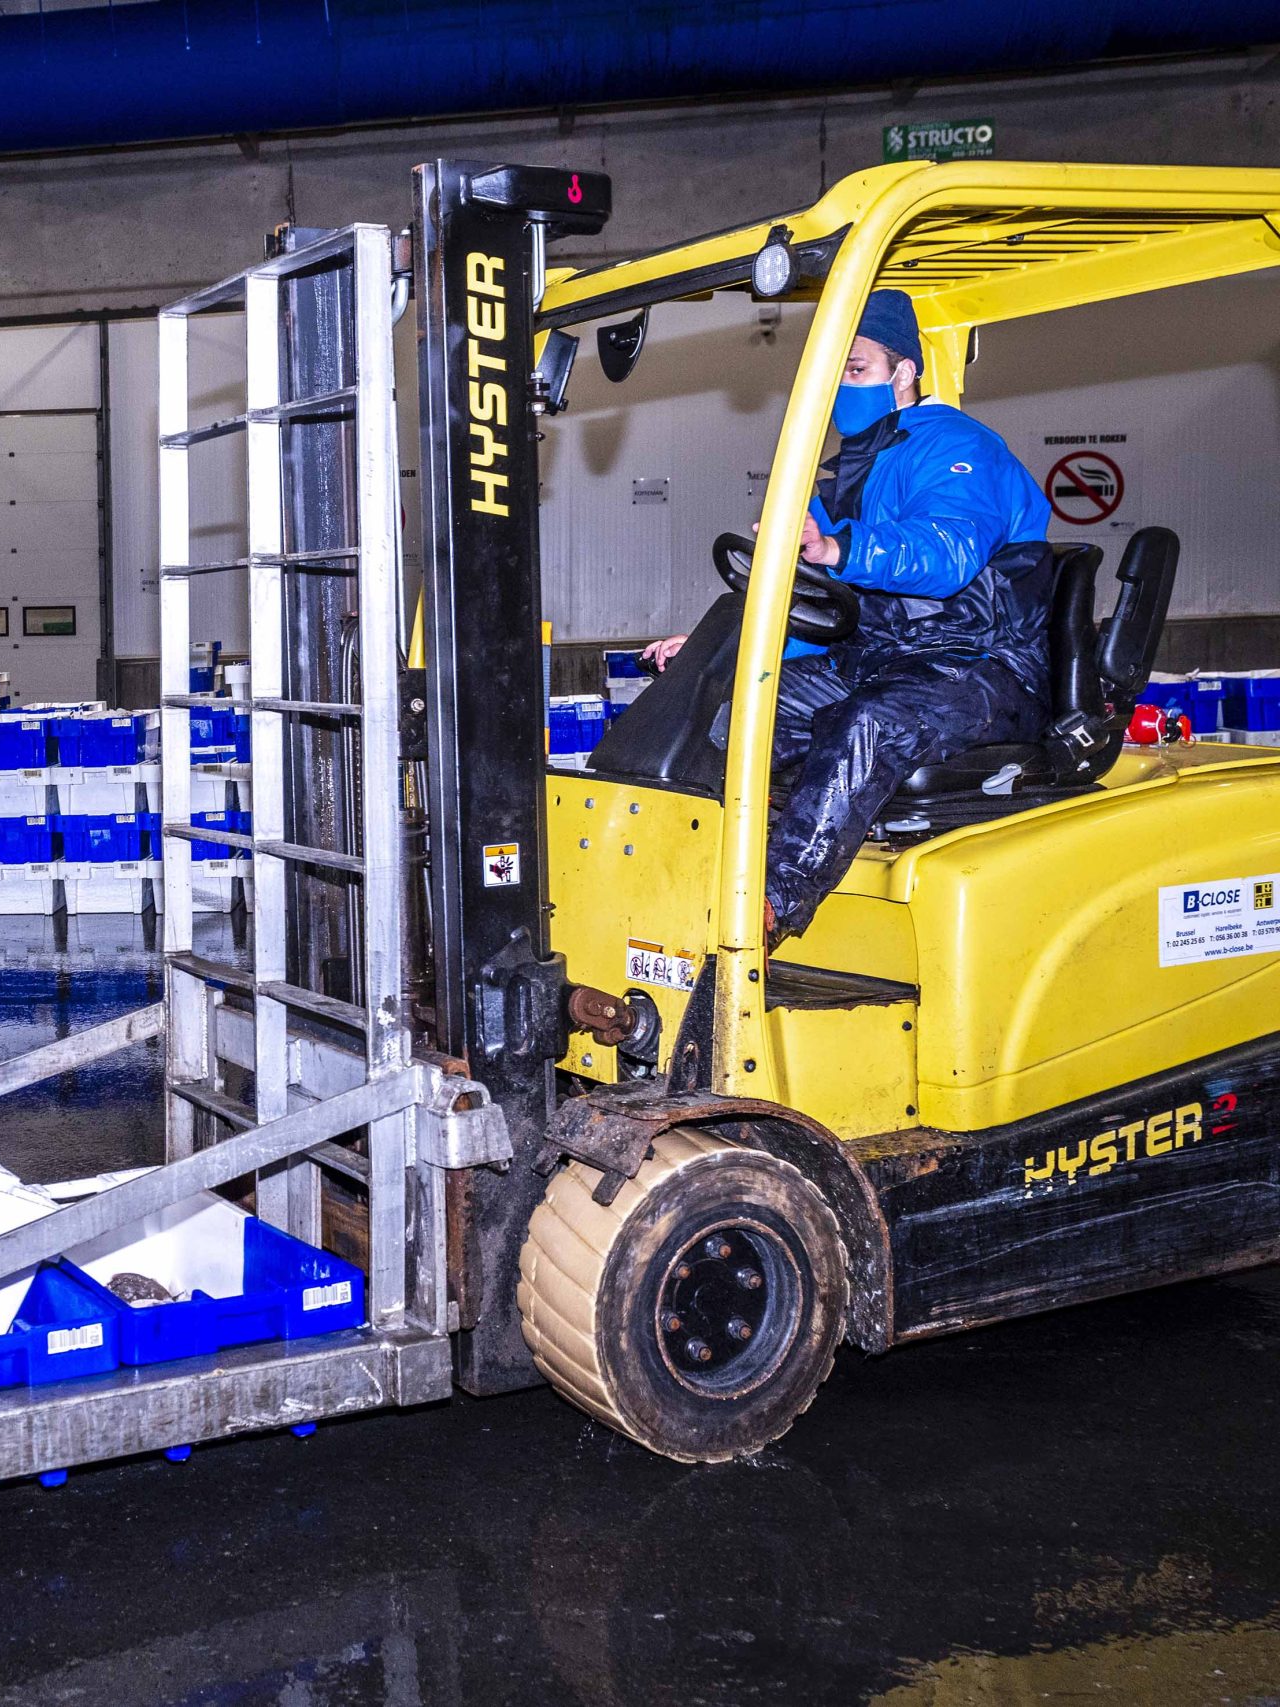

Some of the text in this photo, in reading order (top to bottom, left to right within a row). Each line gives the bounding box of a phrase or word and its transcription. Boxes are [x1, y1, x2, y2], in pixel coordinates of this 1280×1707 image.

[908, 125, 993, 148] STRUCTO
[466, 251, 510, 517] HYSTER
[1044, 434, 1127, 445] VERBODEN TE ROKEN
[1185, 889, 1241, 910] B-CLOSE
[1215, 923, 1242, 932] Harelbeke
[1265, 927, 1275, 935] 570
[1176, 929, 1196, 938] Brussel
[1180, 938, 1190, 947] 245
[1204, 944, 1254, 956] www.b-close.be
[1024, 1102, 1203, 1199] HYSTER
